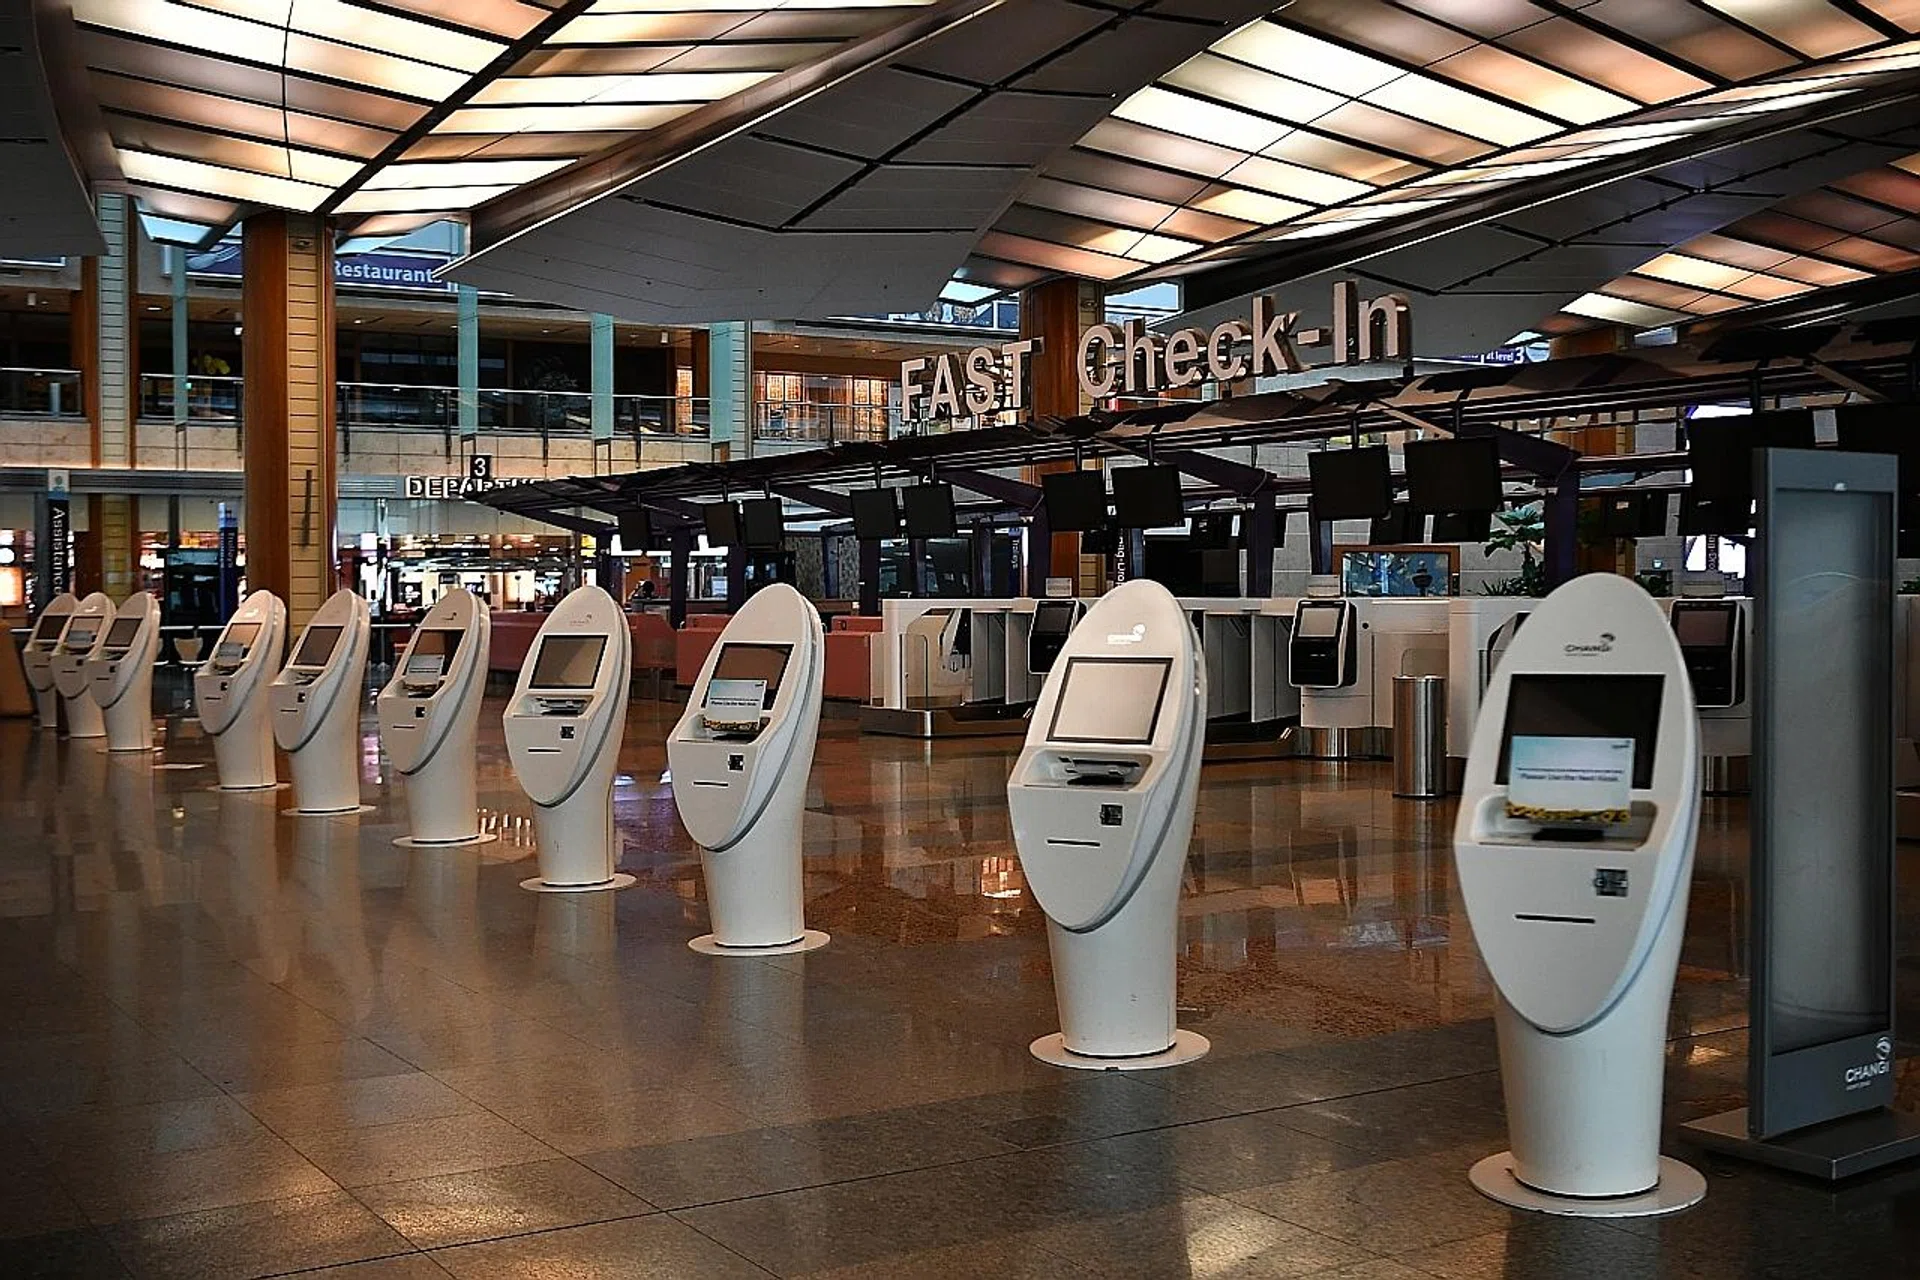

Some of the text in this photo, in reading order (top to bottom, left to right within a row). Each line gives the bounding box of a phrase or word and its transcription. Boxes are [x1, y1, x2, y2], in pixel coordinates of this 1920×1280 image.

[900, 280, 1406, 421] FAST Check-In
[1514, 346, 1525, 364] 3
[473, 457, 487, 477] 3
